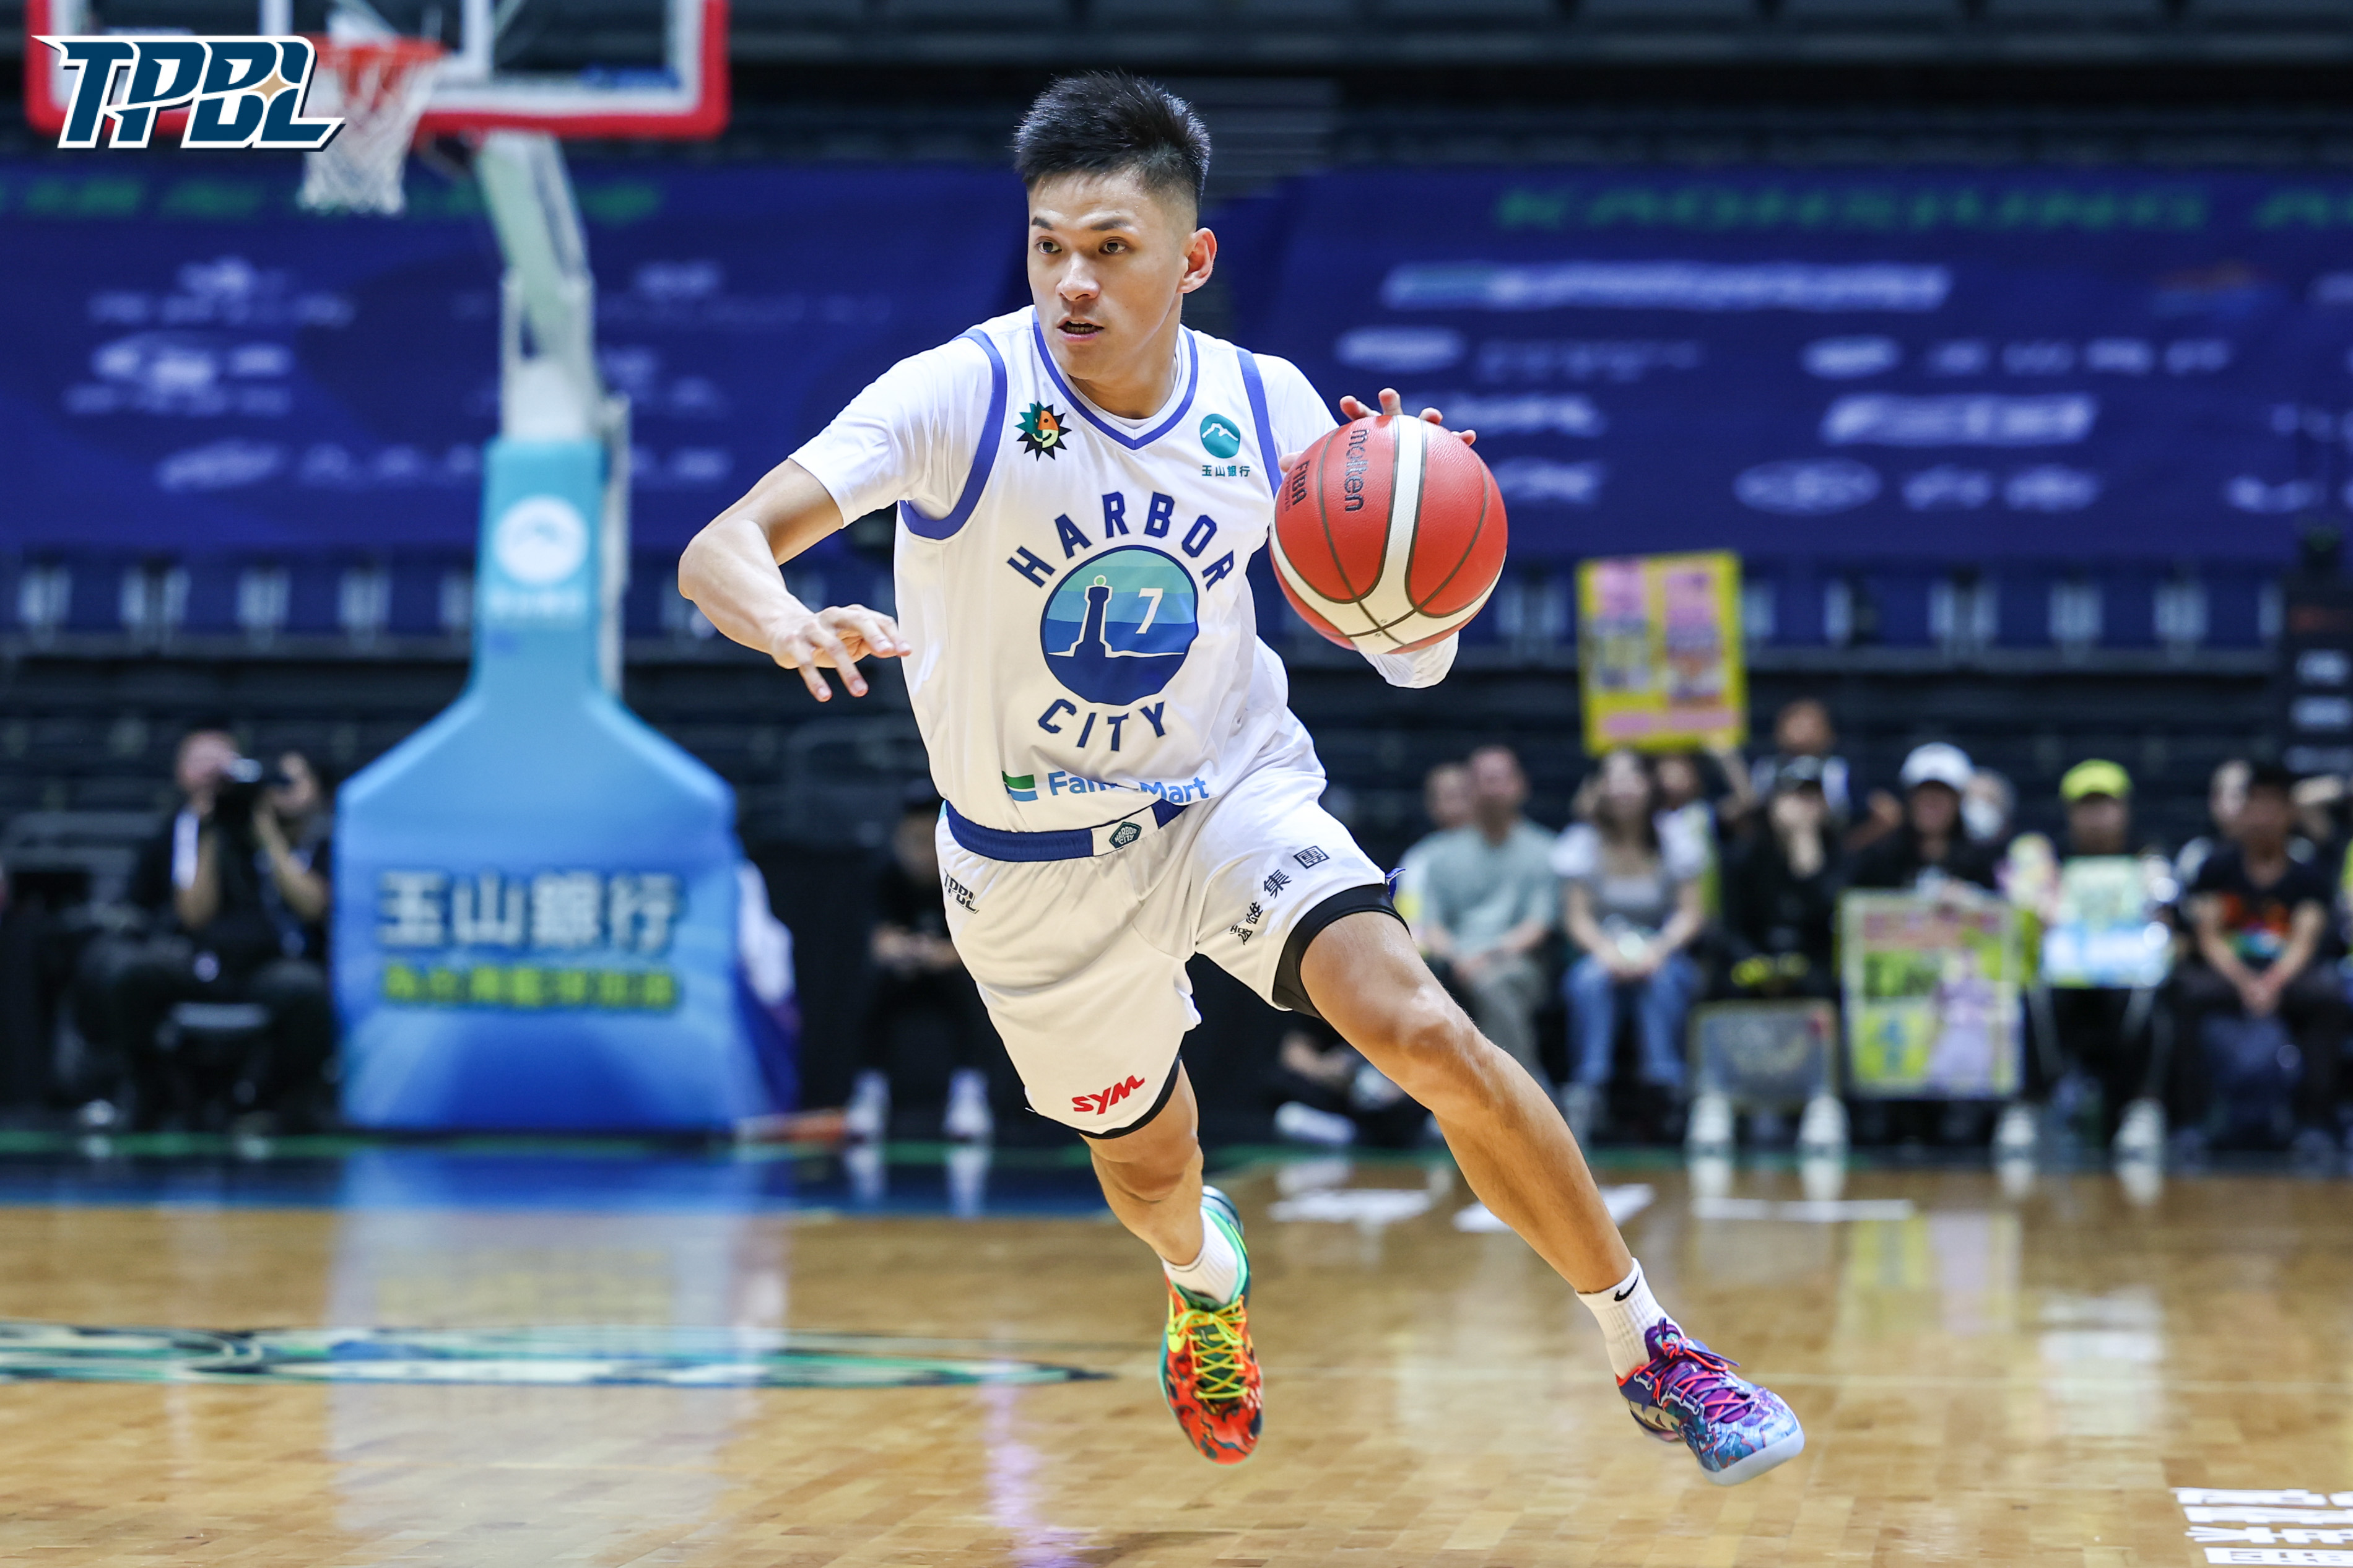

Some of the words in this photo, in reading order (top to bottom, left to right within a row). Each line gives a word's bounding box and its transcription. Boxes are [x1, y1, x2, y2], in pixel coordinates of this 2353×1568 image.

[1201, 465, 1250, 477] 玉山銀行
[1292, 460, 1310, 506] FIBA
[1344, 429, 1370, 512] molten
[1006, 491, 1234, 592] HARBOR
[1135, 587, 1163, 634] 7
[1037, 698, 1167, 752] CITY
[1048, 771, 1209, 803] FamMart
[1115, 826, 1137, 842] HARBOR
[1118, 834, 1134, 845] CITY
[1071, 1075, 1145, 1115] SYM
